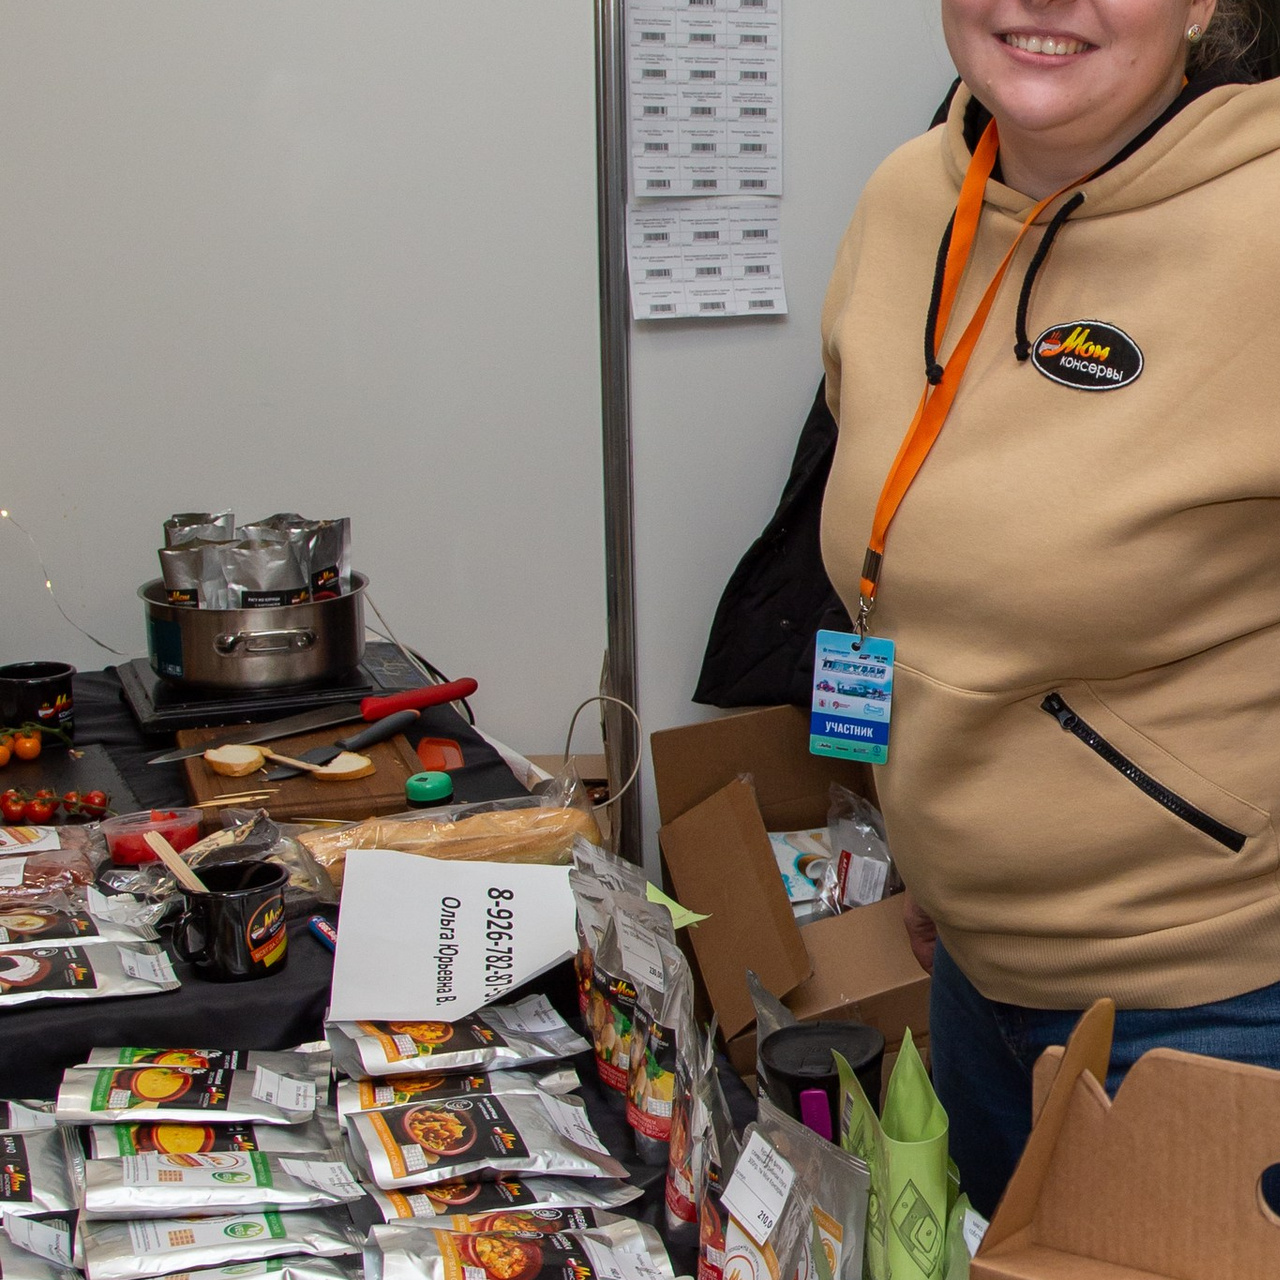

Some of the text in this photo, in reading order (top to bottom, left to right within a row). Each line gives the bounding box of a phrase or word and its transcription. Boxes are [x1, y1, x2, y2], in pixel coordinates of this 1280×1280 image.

[825, 721, 873, 738] УЧАСТНИК
[439, 897, 461, 940] Ольга
[433, 944, 459, 994] Юрьевна
